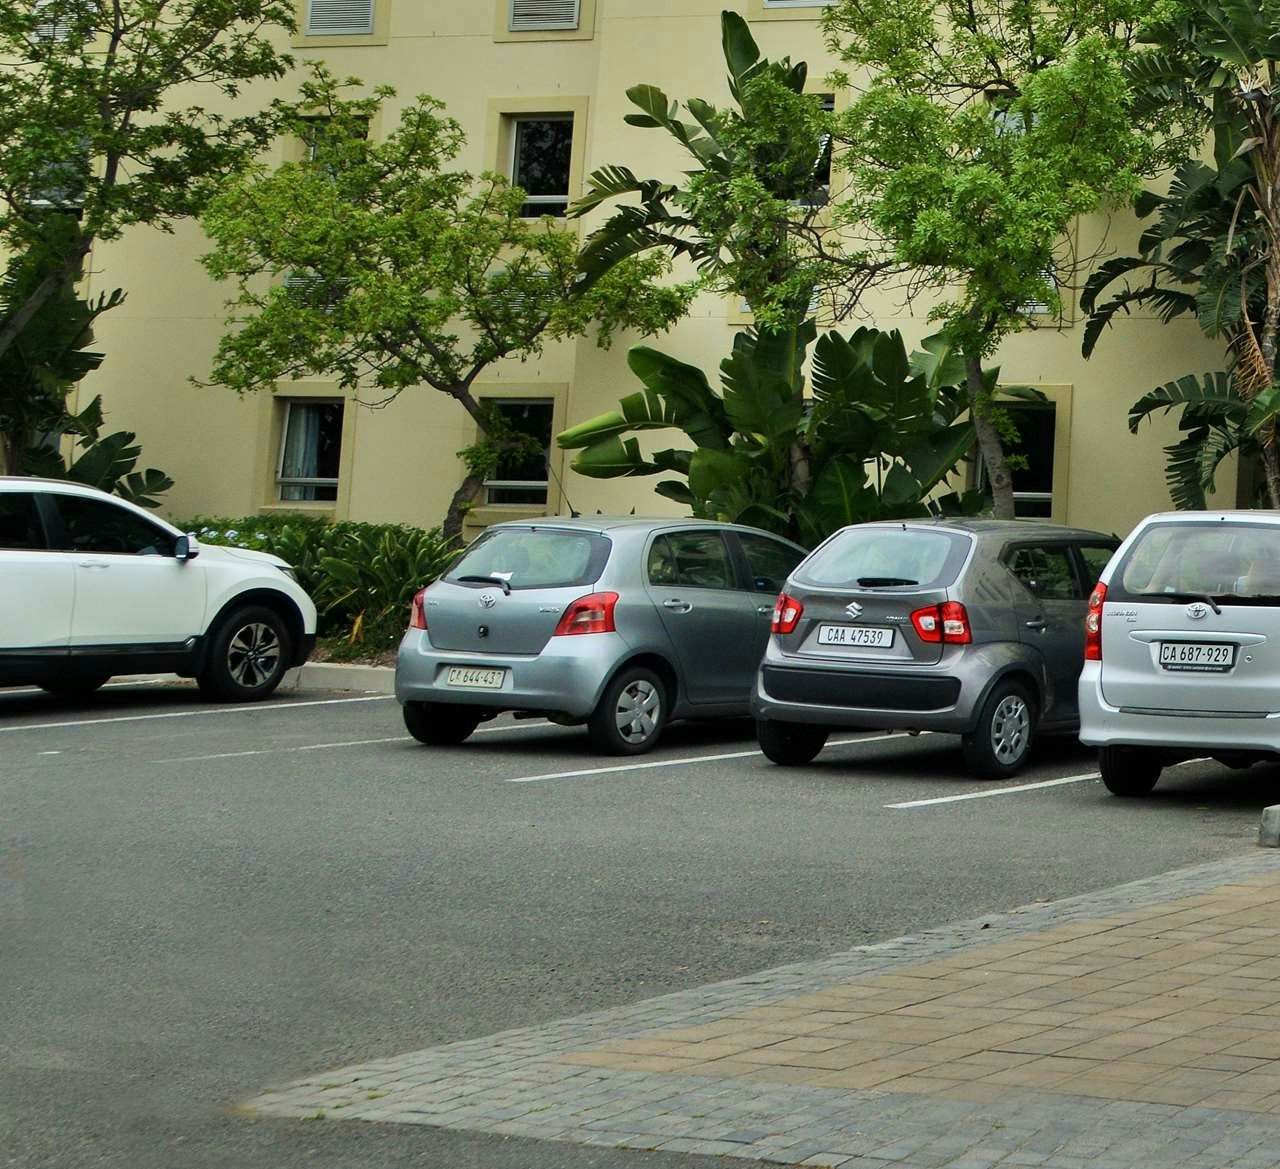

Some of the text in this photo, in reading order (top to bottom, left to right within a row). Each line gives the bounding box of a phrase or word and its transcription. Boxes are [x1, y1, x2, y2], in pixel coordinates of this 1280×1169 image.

[827, 628, 884, 644] CAA 47539
[1163, 646, 1229, 662] CA 687-929
